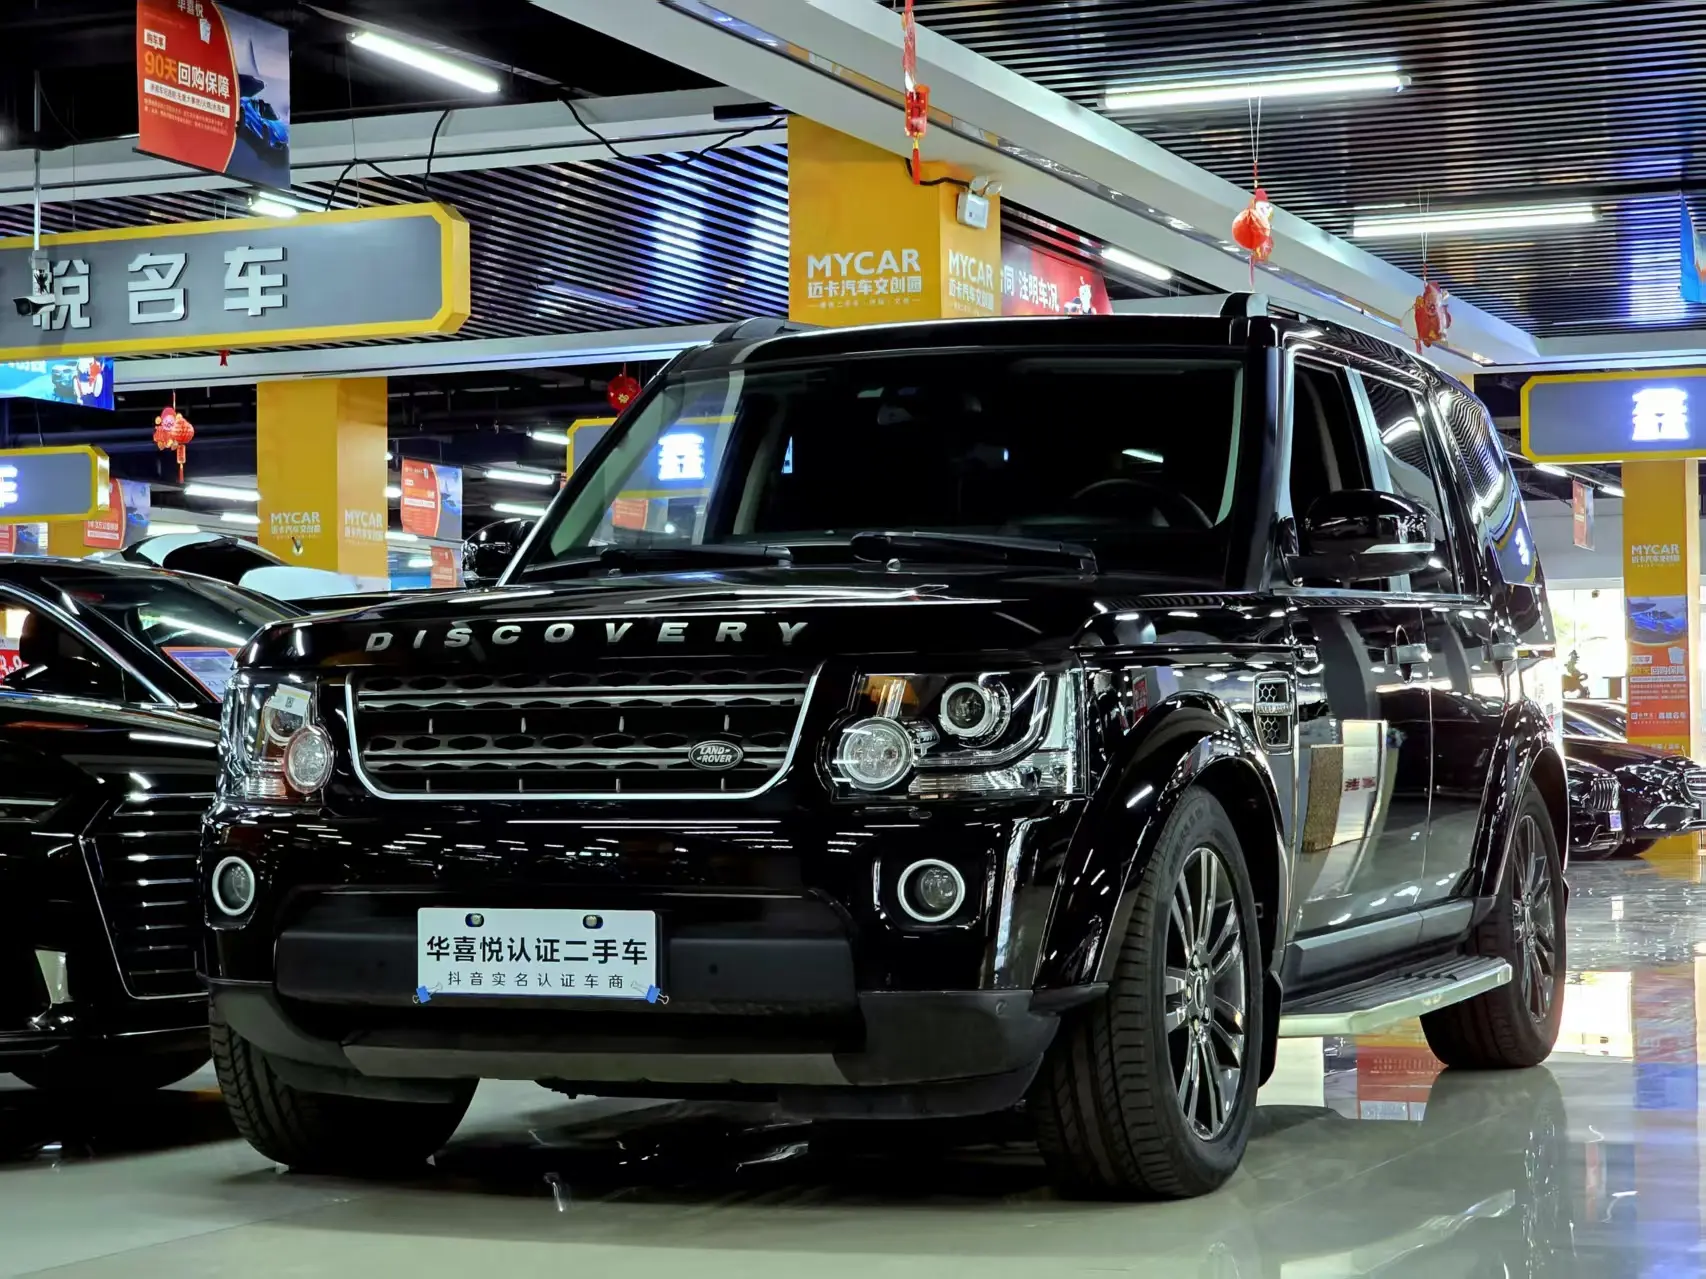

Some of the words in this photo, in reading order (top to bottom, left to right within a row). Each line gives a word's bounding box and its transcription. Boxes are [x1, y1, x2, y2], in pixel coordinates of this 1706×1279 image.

[144, 50, 230, 99] 90天回购保障
[807, 248, 921, 279] MYCAR
[948, 249, 994, 290] MYCAR
[807, 275, 922, 299] 迈卡汽车文创园
[1000, 265, 1014, 297] 同
[270, 511, 321, 524] MYCAR
[344, 508, 384, 528] MYCAR
[1631, 543, 1680, 555] MYCAR
[365, 621, 808, 652] DISCOVERY
[700, 746, 725, 755] LAND
[702, 754, 732, 763] ROVER
[426, 935, 648, 965] 华喜悦认证二手车
[448, 971, 624, 989] 抖音实名认证车商
